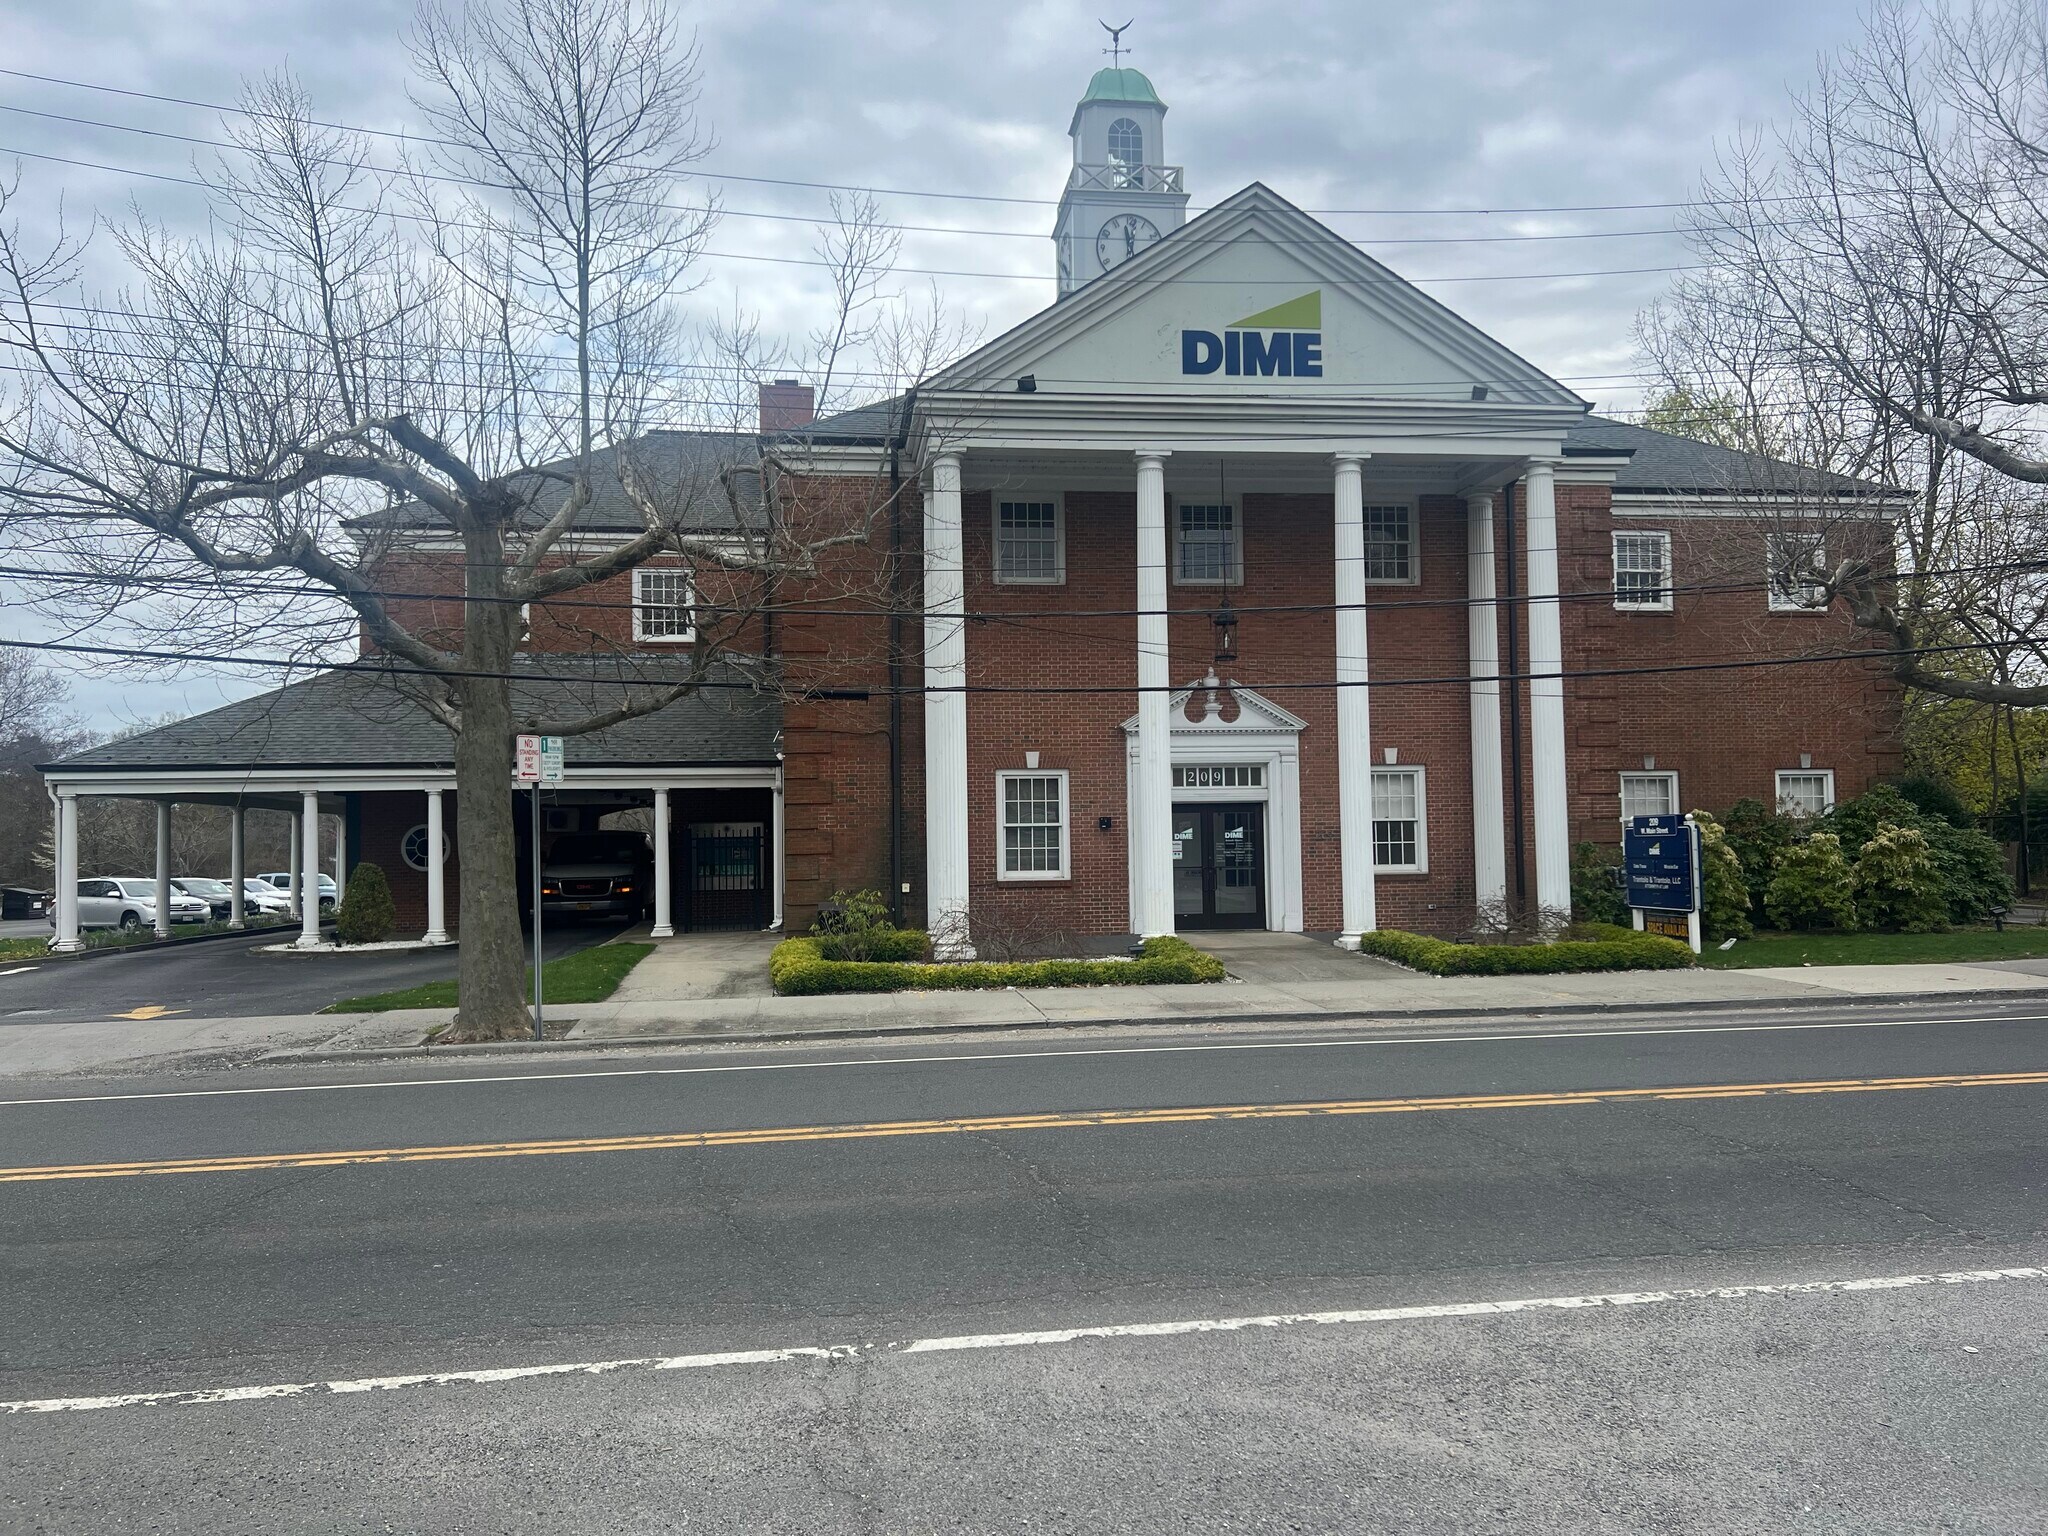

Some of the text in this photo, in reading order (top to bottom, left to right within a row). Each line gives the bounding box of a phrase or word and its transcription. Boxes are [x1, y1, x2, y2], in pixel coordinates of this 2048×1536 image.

[1102, 229, 1110, 239] 10
[1100, 244, 1105, 253] 9
[1182, 330, 1323, 377] DIME
[524, 739, 533, 748] NO
[1188, 772, 1221, 782] 209
[1649, 818, 1659, 826] 209
[1672, 877, 1681, 885] LLC
[1647, 921, 1688, 937] SPACE AVAILABL
